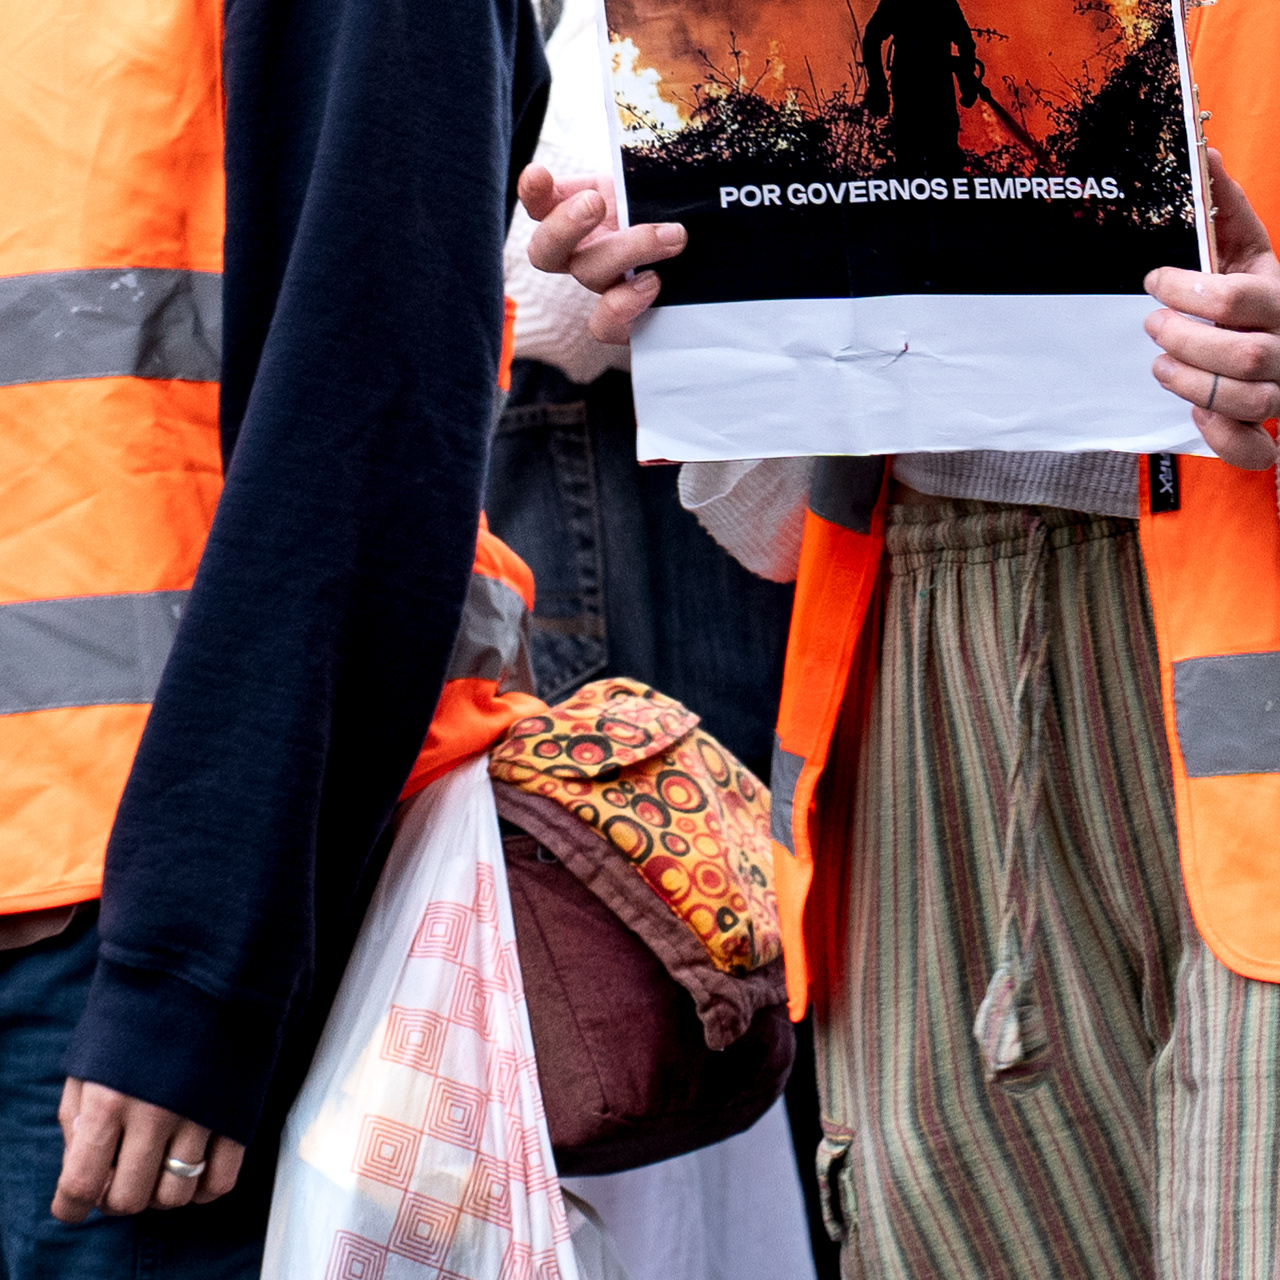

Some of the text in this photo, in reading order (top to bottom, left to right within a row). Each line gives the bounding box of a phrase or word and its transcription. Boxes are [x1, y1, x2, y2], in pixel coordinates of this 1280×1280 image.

[719, 176, 1126, 209] POR GOVERNOS E EMPRESAS.
